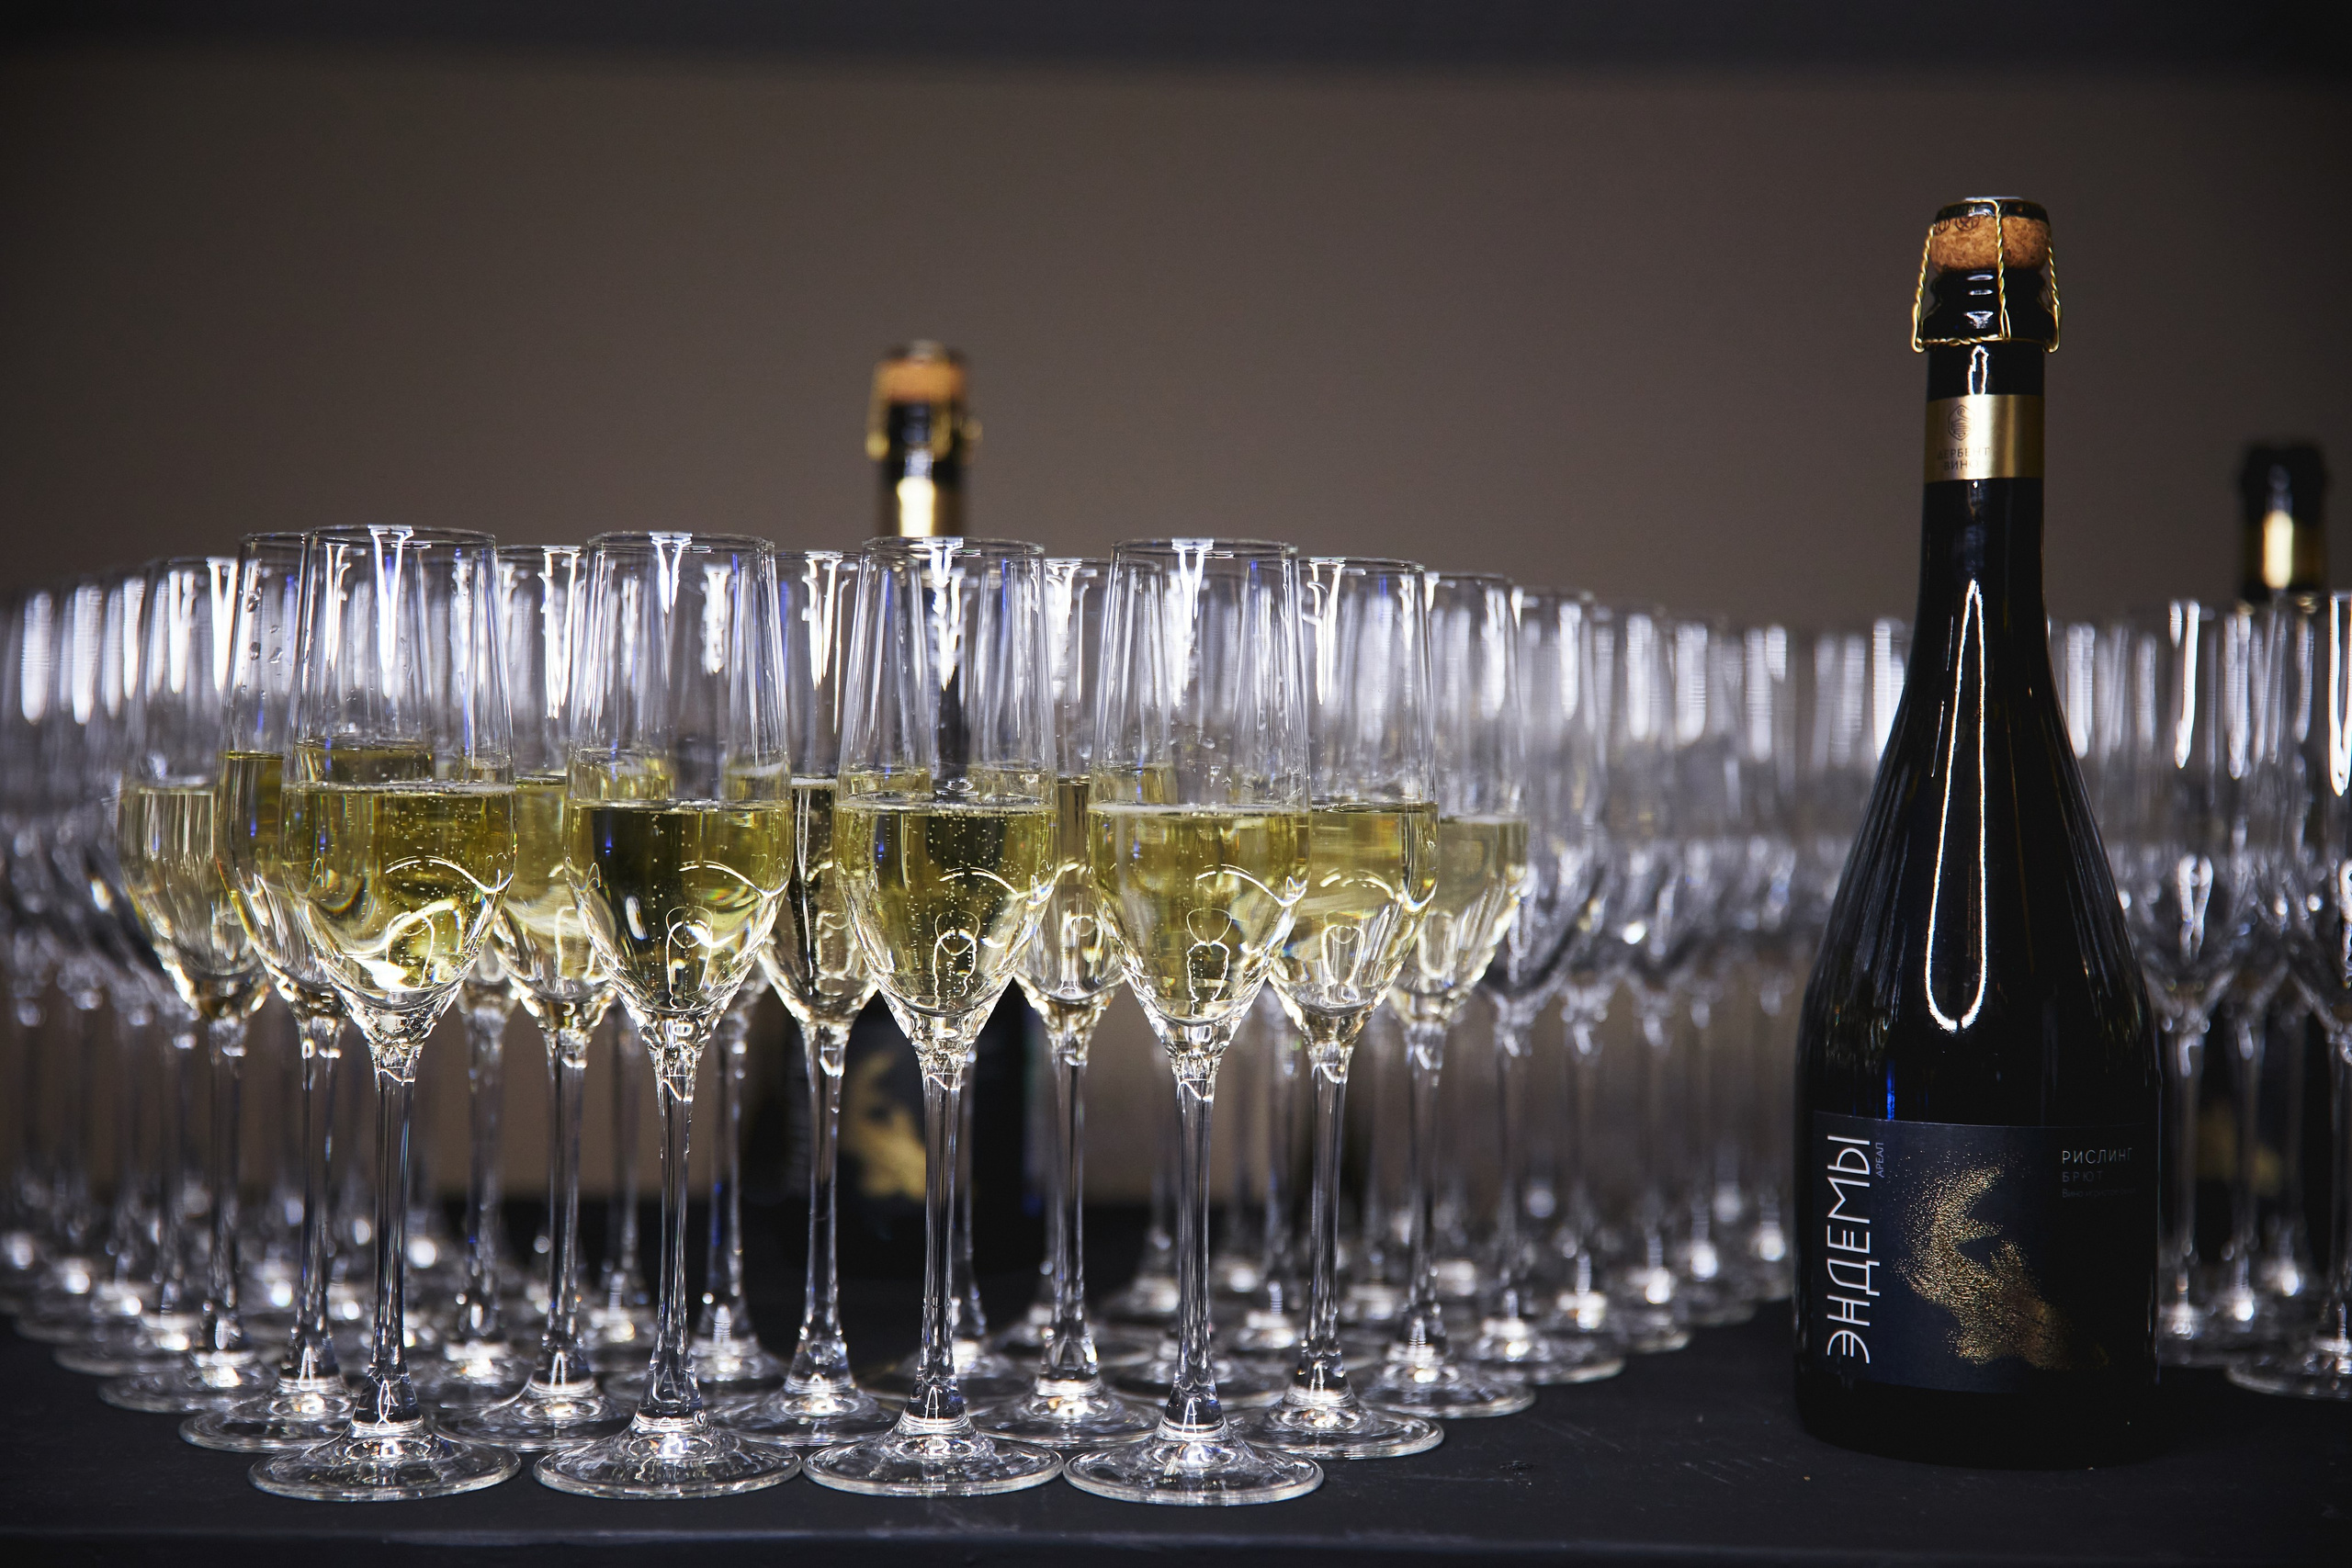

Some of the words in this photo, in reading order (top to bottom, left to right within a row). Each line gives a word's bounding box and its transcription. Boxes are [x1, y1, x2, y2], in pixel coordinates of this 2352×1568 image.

[1875, 1142, 1885, 1178] АРЕАЛ
[2062, 1147, 2132, 1165] РИСЛИНГ
[2062, 1170, 2103, 1183] БРЮТ
[1826, 1134, 1881, 1364] ЭНДЕМЫ
